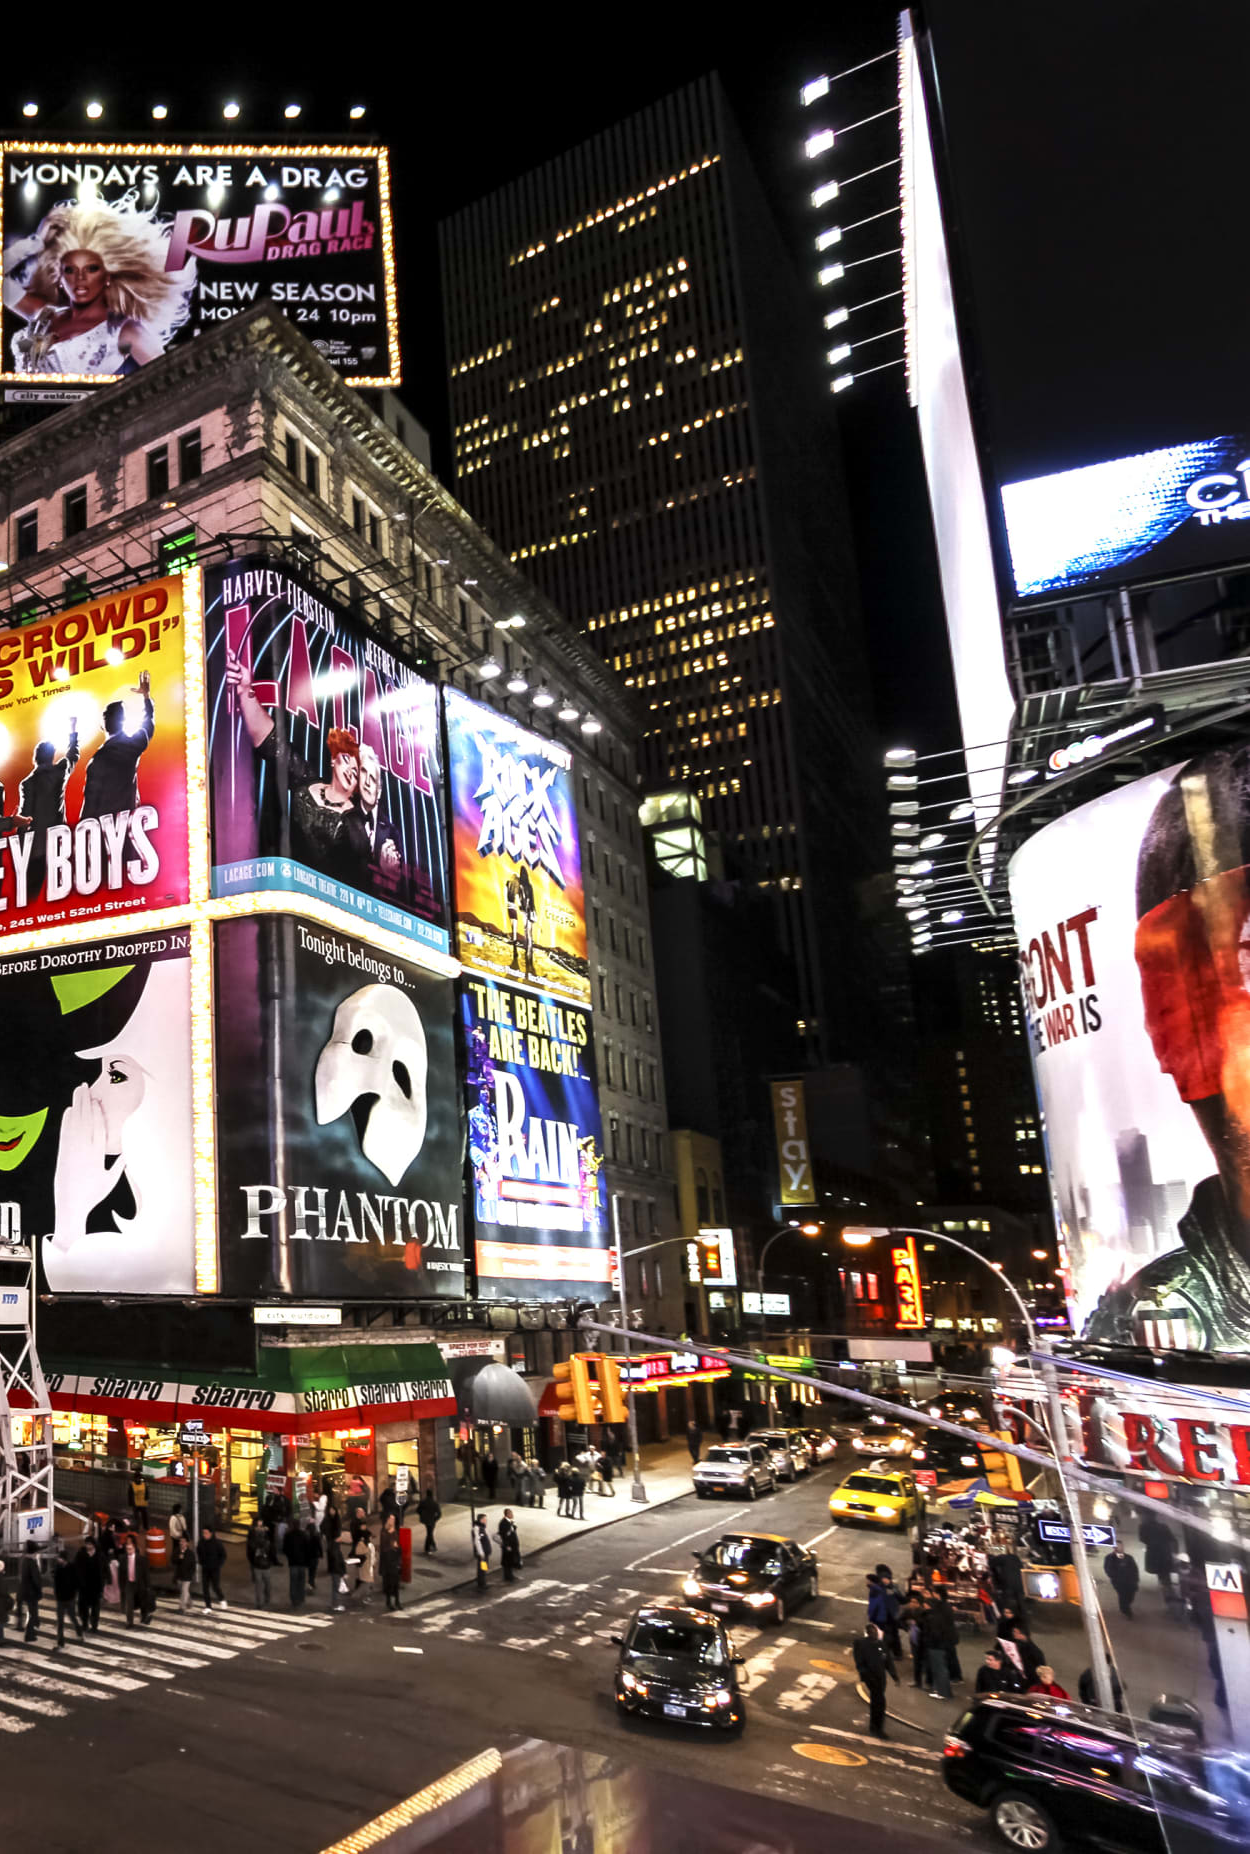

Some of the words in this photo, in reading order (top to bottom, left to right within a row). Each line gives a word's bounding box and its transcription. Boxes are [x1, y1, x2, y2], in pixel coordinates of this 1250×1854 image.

[9, 163, 159, 186] MONDAYS
[173, 164, 232, 187] ARE
[245, 165, 268, 187] A
[282, 167, 368, 188] DRAG
[266, 240, 322, 262] DRAG
[326, 235, 375, 255] RACE
[199, 282, 260, 301] NEW
[271, 282, 376, 302] SEASON
[296, 308, 321, 323] 24
[329, 308, 377, 325] 10pm
[343, 358, 359, 366] 155
[222, 568, 284, 606] HARVEY
[287, 579, 336, 638] FIERSTEIN
[365, 636, 397, 681] JEFFREY
[17, 695, 40, 709] York
[42, 683, 71, 700] Times
[473, 732, 562, 842] ROCK
[46, 805, 160, 902] BOYS
[224, 861, 276, 884] LACAGE.COM
[8, 916, 34, 929] 245
[36, 910, 67, 924] West
[68, 901, 103, 918] 52nd
[104, 896, 147, 915] Street
[39, 948, 104, 972] DOROTHY
[105, 938, 168, 962] DROPPED
[297, 924, 347, 967] Tonight
[347, 947, 393, 986] belongs
[514, 996, 588, 1047] BEATLES
[1042, 1002, 1078, 1048] WAR
[1079, 993, 1102, 1035] IS
[489, 1024, 526, 1067] ARE
[492, 1069, 582, 1186] RAIN
[239, 1182, 461, 1252] PHANTOM
[1, 1293, 19, 1305] NYPD
[891, 1248, 918, 1322] PARK
[90, 1373, 164, 1401] sbarro
[192, 1382, 277, 1411] sbarro
[304, 1385, 351, 1413] sbarro
[360, 1382, 402, 1406] sbarro
[411, 1379, 449, 1401] sbarro
[26, 1516, 43, 1529] NYPD
